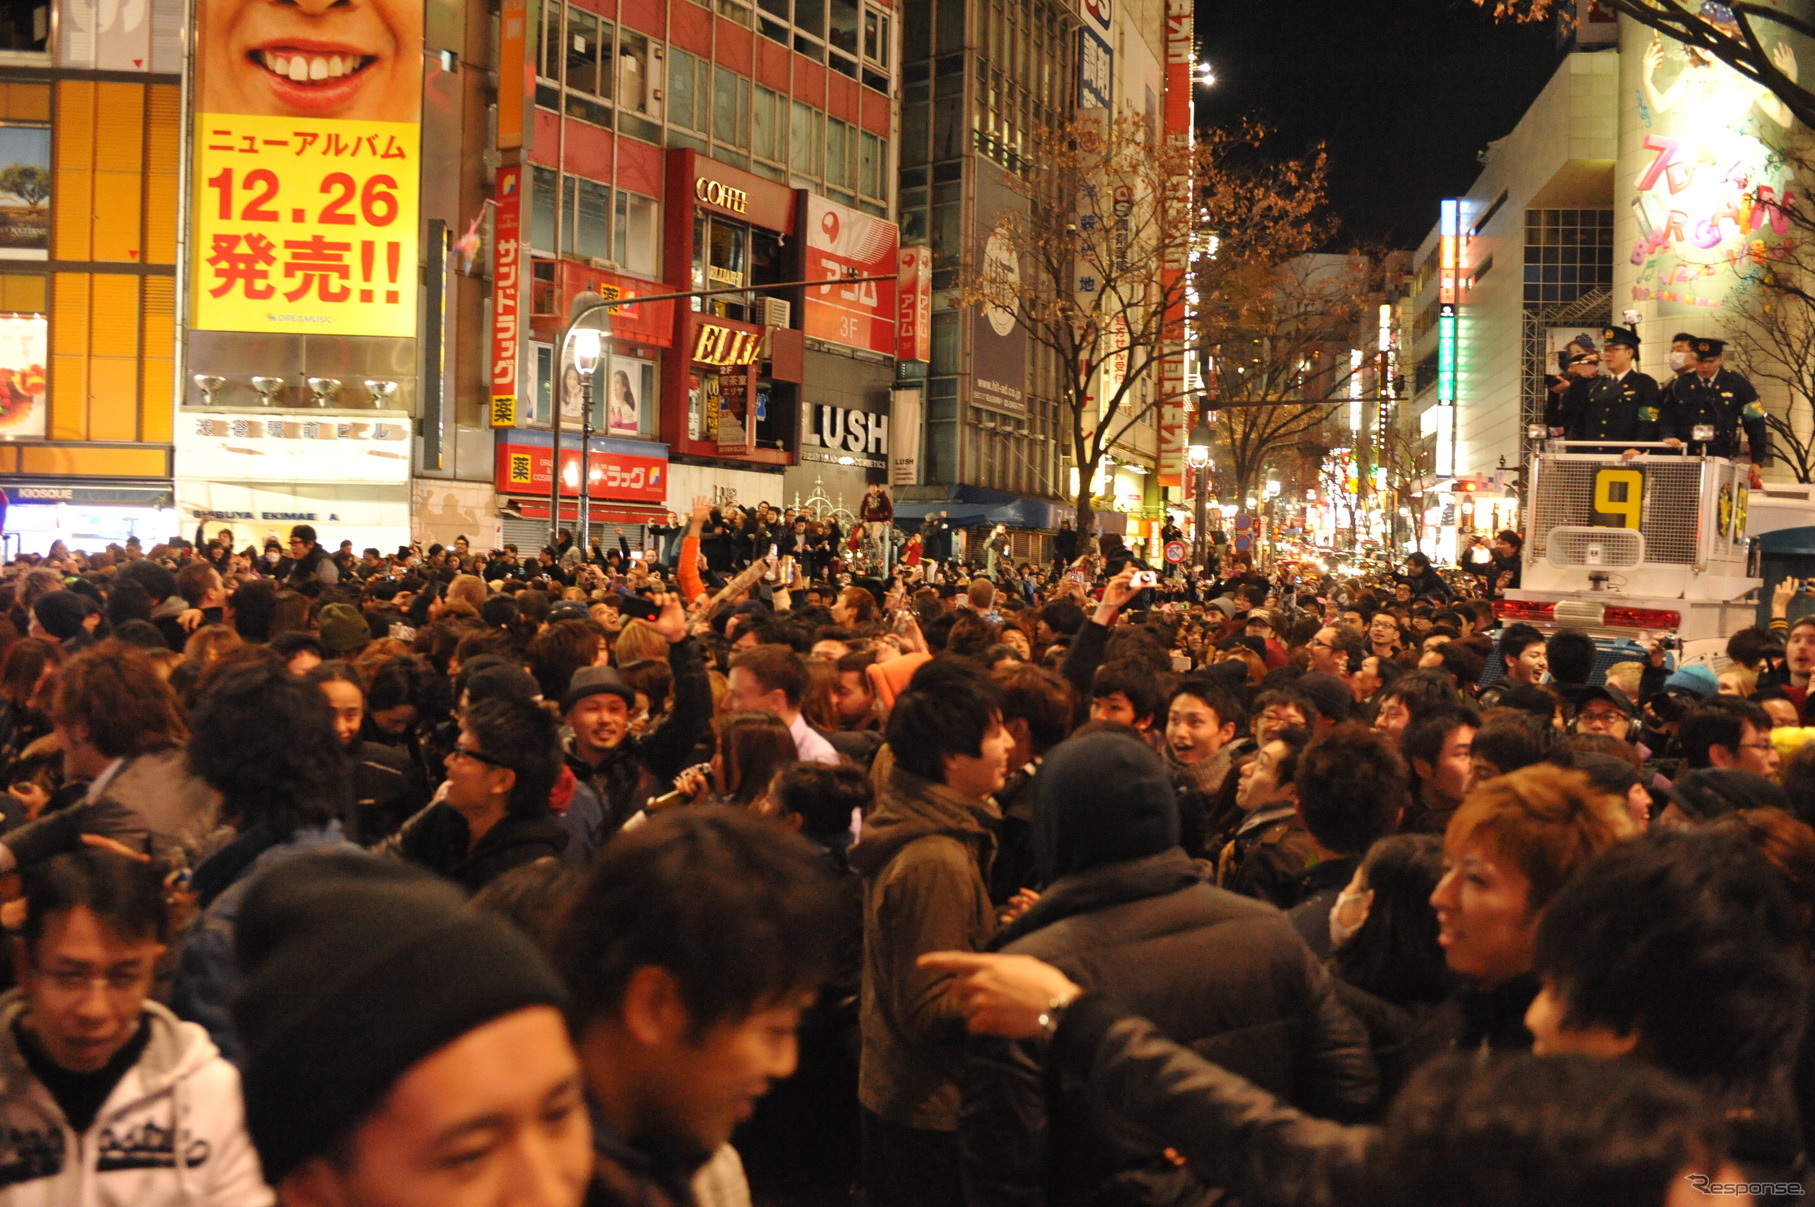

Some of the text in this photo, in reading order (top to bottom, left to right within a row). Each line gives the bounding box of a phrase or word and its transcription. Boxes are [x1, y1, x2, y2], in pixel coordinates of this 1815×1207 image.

[208, 129, 406, 159] ニューアルバム
[1636, 133, 1679, 191] 7
[208, 167, 399, 227] 12.26
[205, 231, 401, 304] 発売!!
[820, 258, 878, 307] アコム
[494, 238, 518, 385] サンドラッグ
[840, 316, 859, 338] 3F
[901, 294, 914, 336] アコム
[494, 398, 513, 422] 薬
[802, 402, 888, 454] LUSH
[512, 456, 529, 480] 薬
[19, 488, 73, 499] KIOSQUE
[1594, 469, 1643, 533] 9
[262, 512, 316, 521] EKIMAE
[328, 513, 339, 521] A
